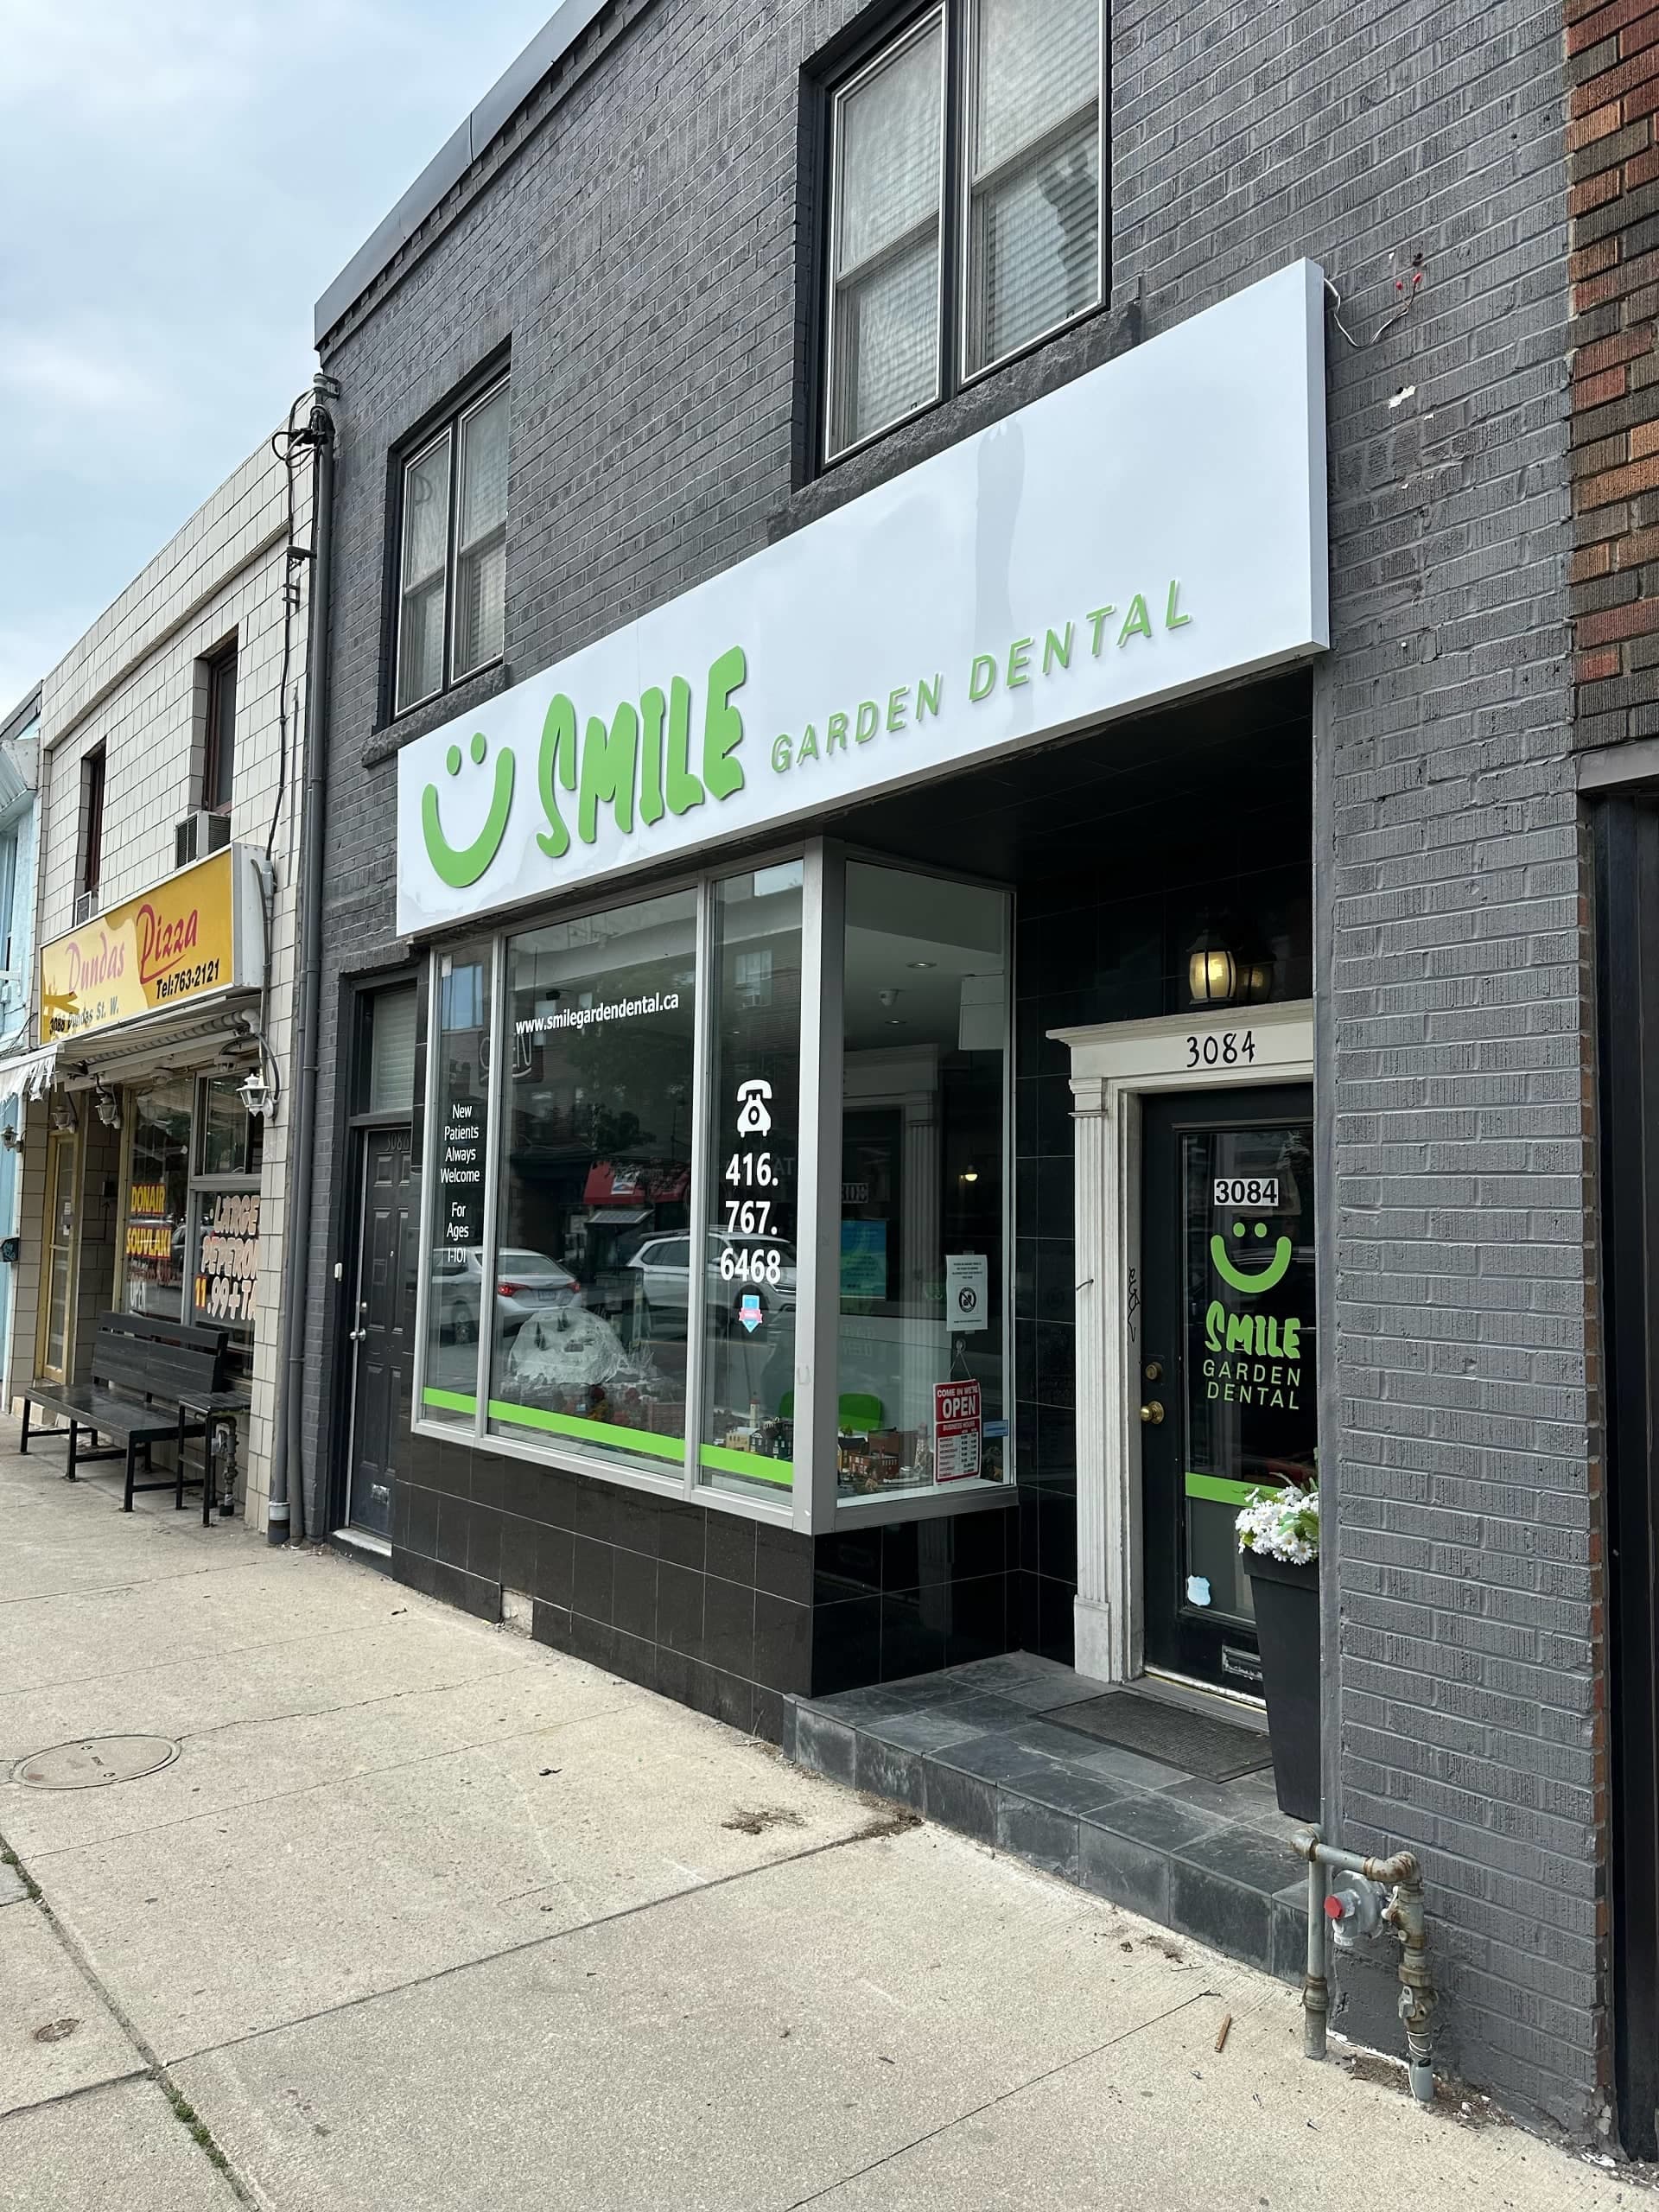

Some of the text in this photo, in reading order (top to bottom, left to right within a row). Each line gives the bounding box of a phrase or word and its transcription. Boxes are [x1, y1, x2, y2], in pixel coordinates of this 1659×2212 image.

[537, 580, 1192, 857] SMILE GARDEN DENTAL
[66, 904, 199, 995] Dundas Pizza
[515, 992, 679, 1034] www.smilegardendental.ca
[1186, 1030, 1255, 1067] 3084
[452, 1103, 473, 1119] New
[444, 1125, 480, 1141] Patients
[445, 1147, 476, 1164] Always
[725, 1152, 779, 1186] 416.
[441, 1167, 480, 1184] Welcome
[131, 1185, 167, 1213] DONAIR
[1215, 1179, 1277, 1205] 3084
[214, 1194, 260, 1237] LARGE
[451, 1201, 467, 1217] For
[725, 1200, 778, 1236] 767.
[126, 1227, 172, 1258] SOUVLAKI
[446, 1222, 469, 1241] Ages
[720, 1247, 781, 1284] 6468
[1205, 1300, 1300, 1359] SMILE
[1203, 1358, 1300, 1387] GARDEN
[937, 1389, 955, 1397] COME
[942, 1395, 976, 1419] OPEN
[1207, 1381, 1299, 1409] DENTAL
